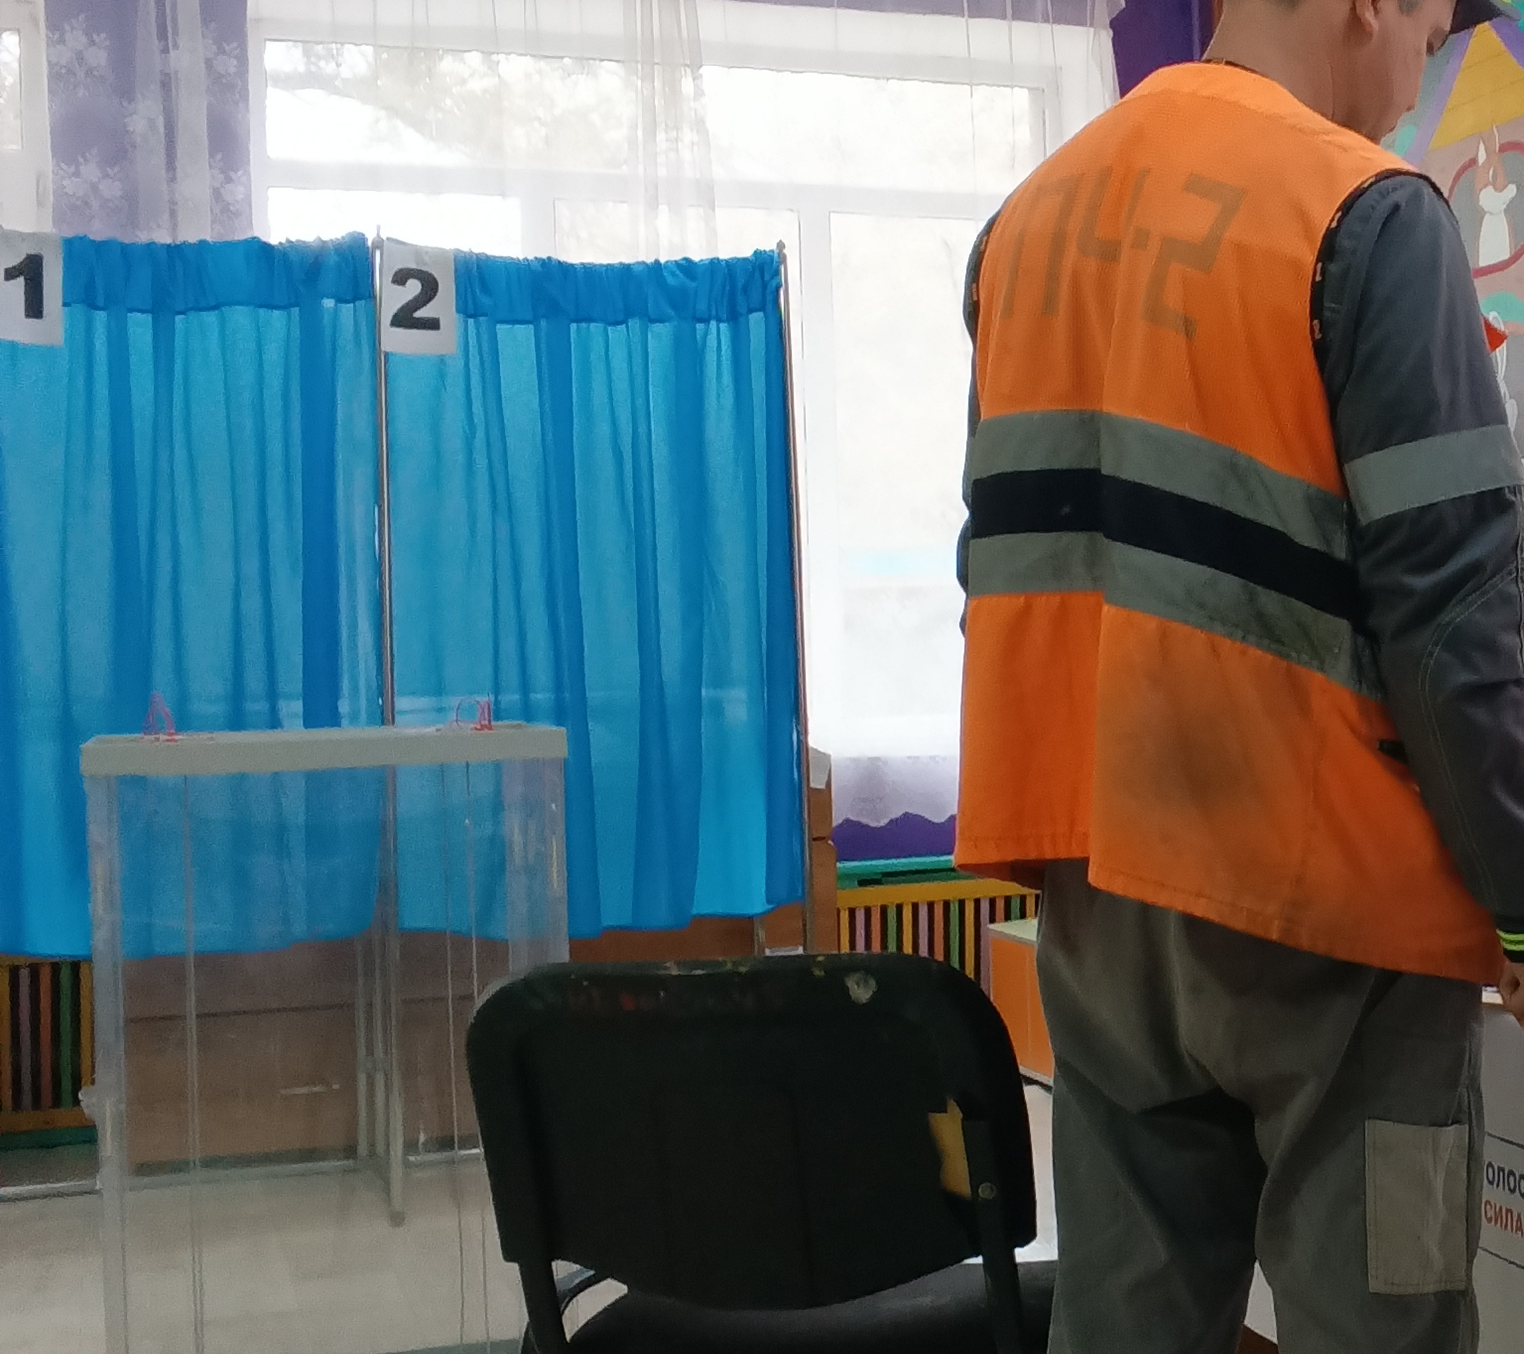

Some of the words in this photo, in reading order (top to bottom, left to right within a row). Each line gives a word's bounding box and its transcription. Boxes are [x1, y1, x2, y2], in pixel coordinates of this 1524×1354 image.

[4, 253, 44, 320] 1
[390, 267, 441, 331] 2
[1483, 1200, 1524, 1240] СИЛА
